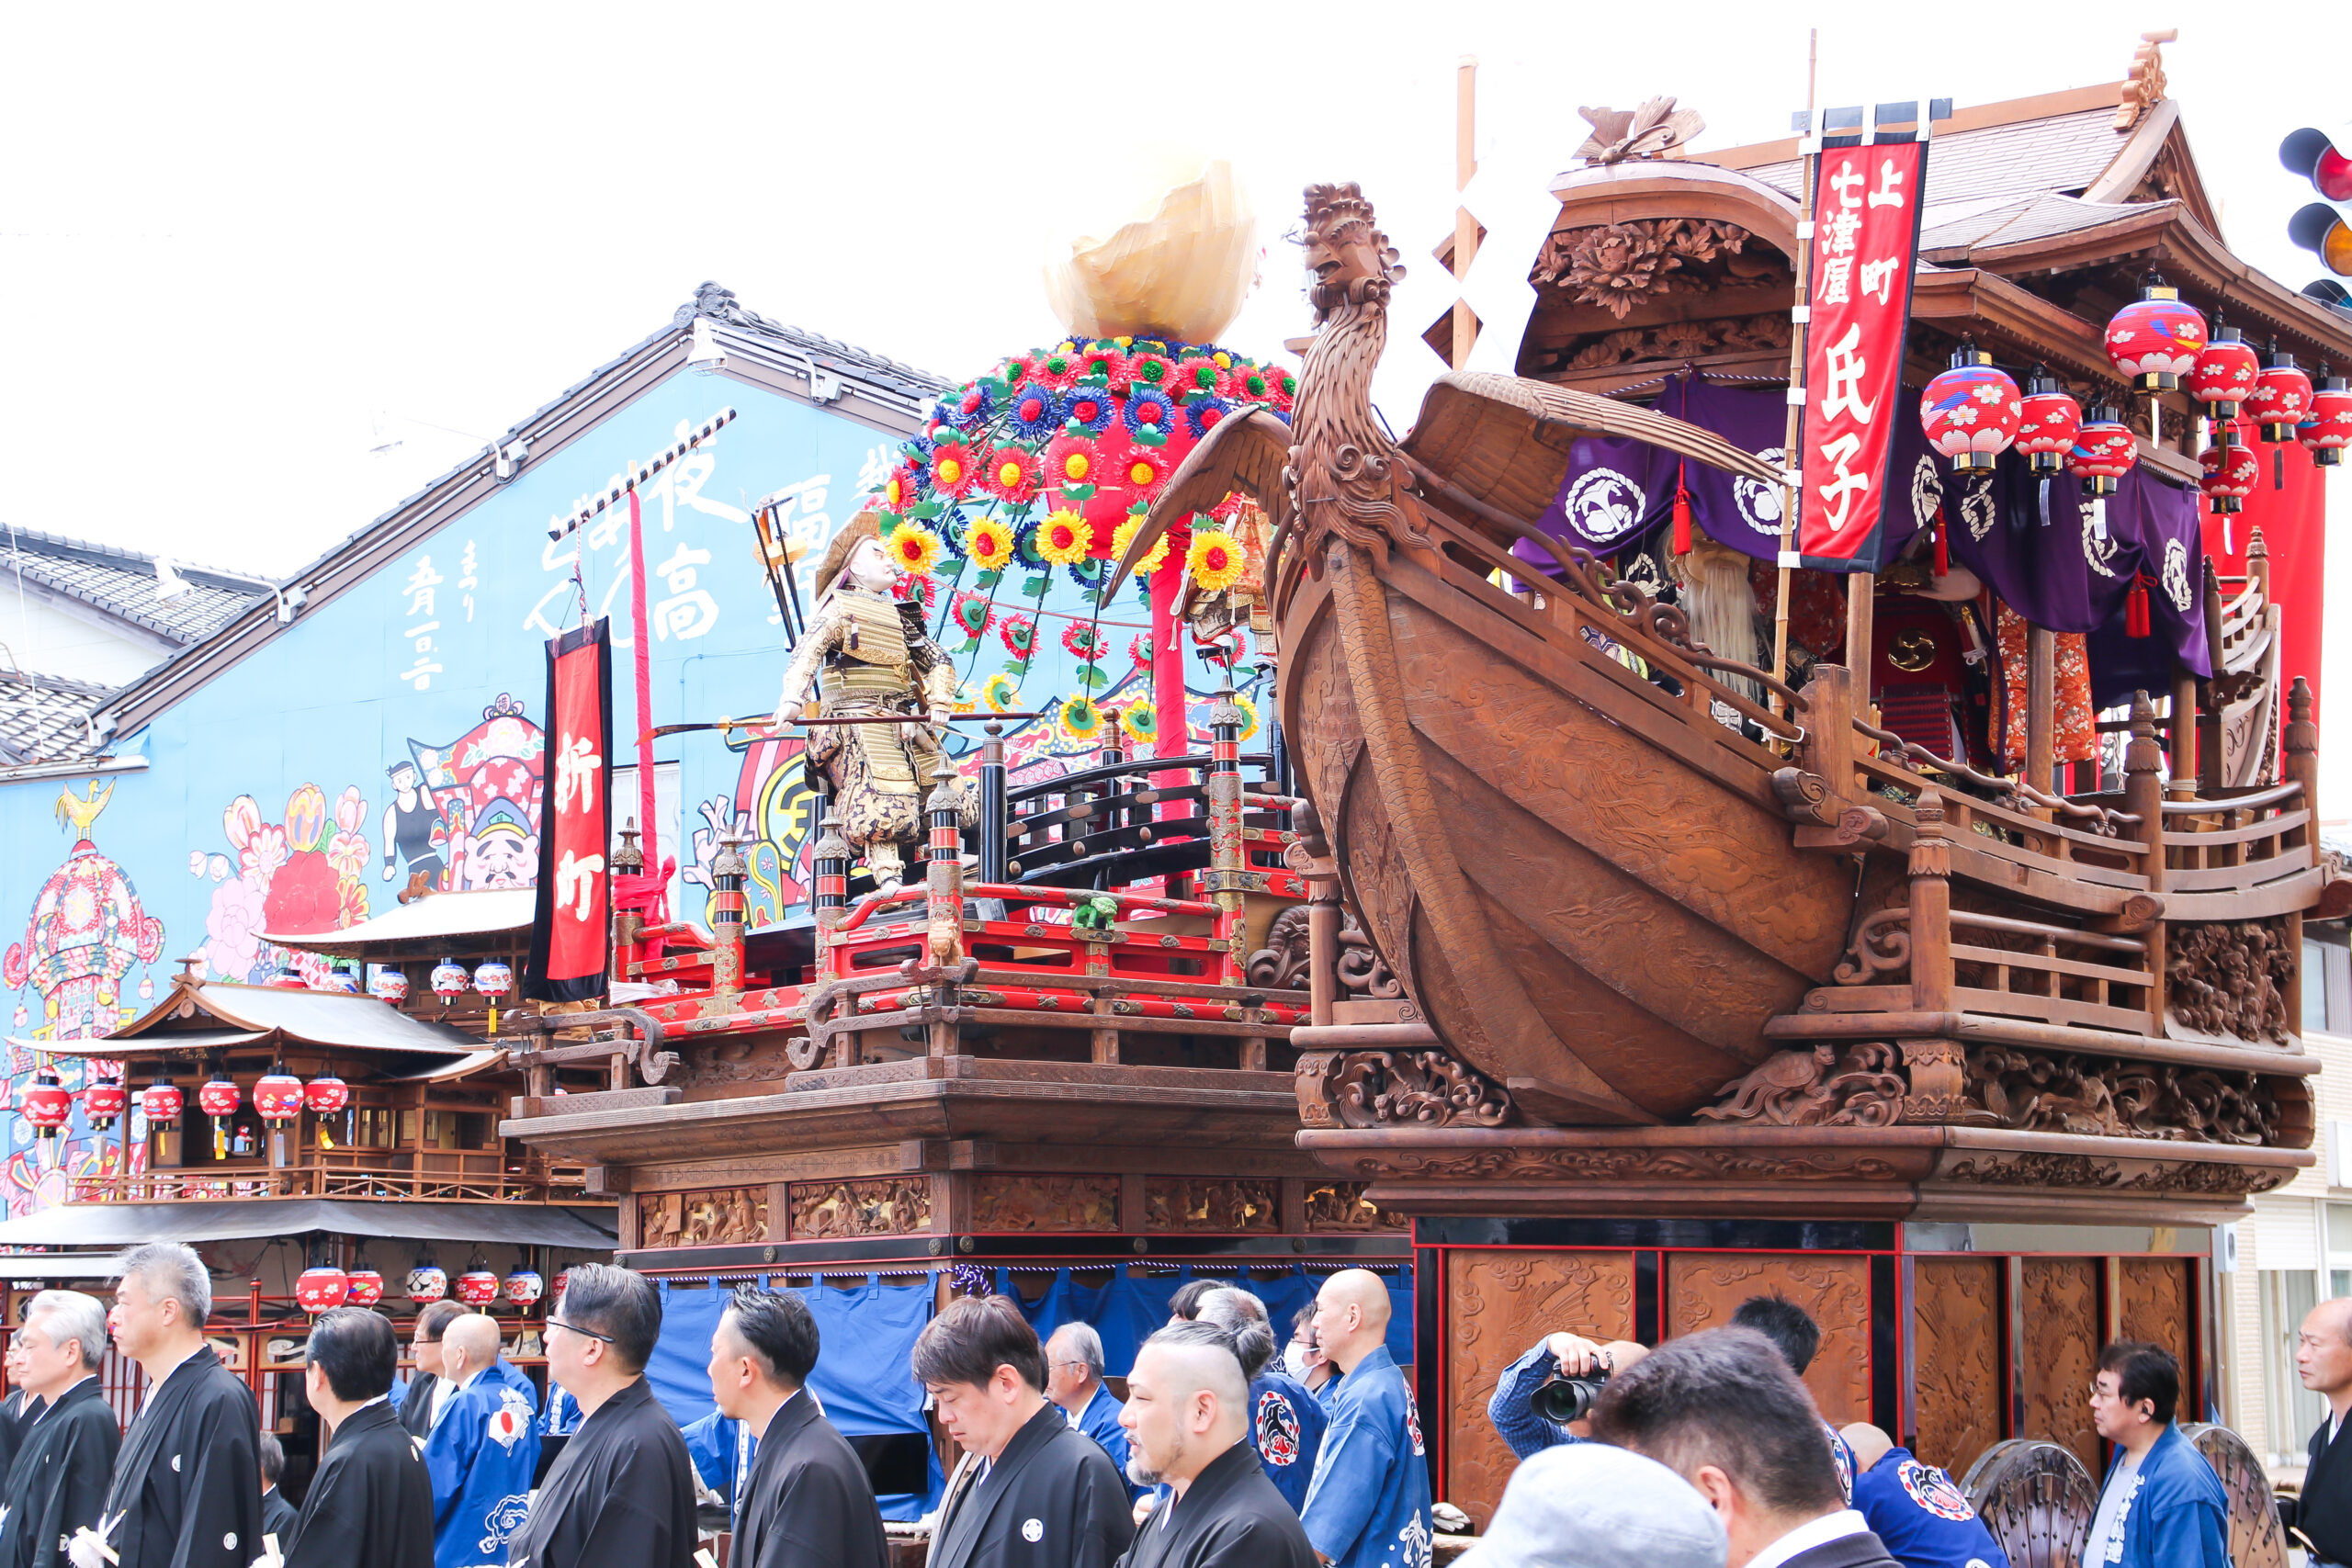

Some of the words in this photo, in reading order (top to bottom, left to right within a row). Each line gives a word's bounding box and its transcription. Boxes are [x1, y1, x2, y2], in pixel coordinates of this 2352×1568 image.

[1817, 161, 1865, 306] 七津屋
[1860, 159, 1904, 307] 上町
[1819, 322, 1877, 532] 氏子
[458, 538, 479, 624] まつり
[555, 732, 605, 921] 新町
